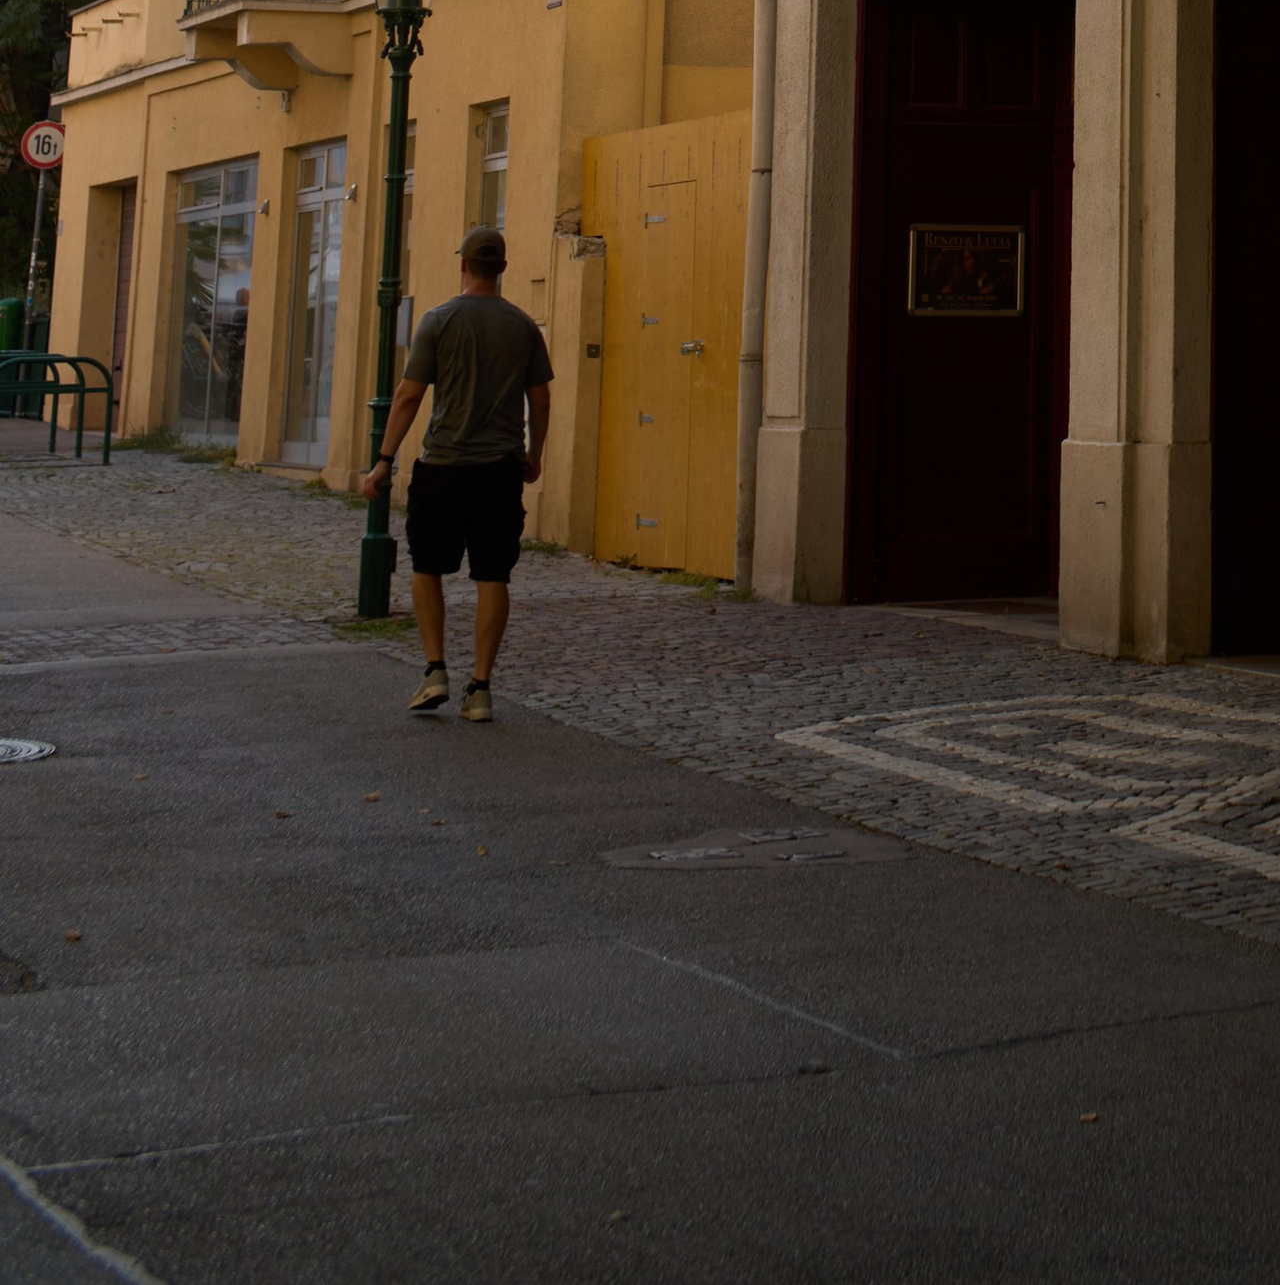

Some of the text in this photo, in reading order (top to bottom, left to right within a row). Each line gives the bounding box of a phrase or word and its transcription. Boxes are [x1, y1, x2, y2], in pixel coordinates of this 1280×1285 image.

[925, 231, 1012, 246] RENZO & LUCIA
